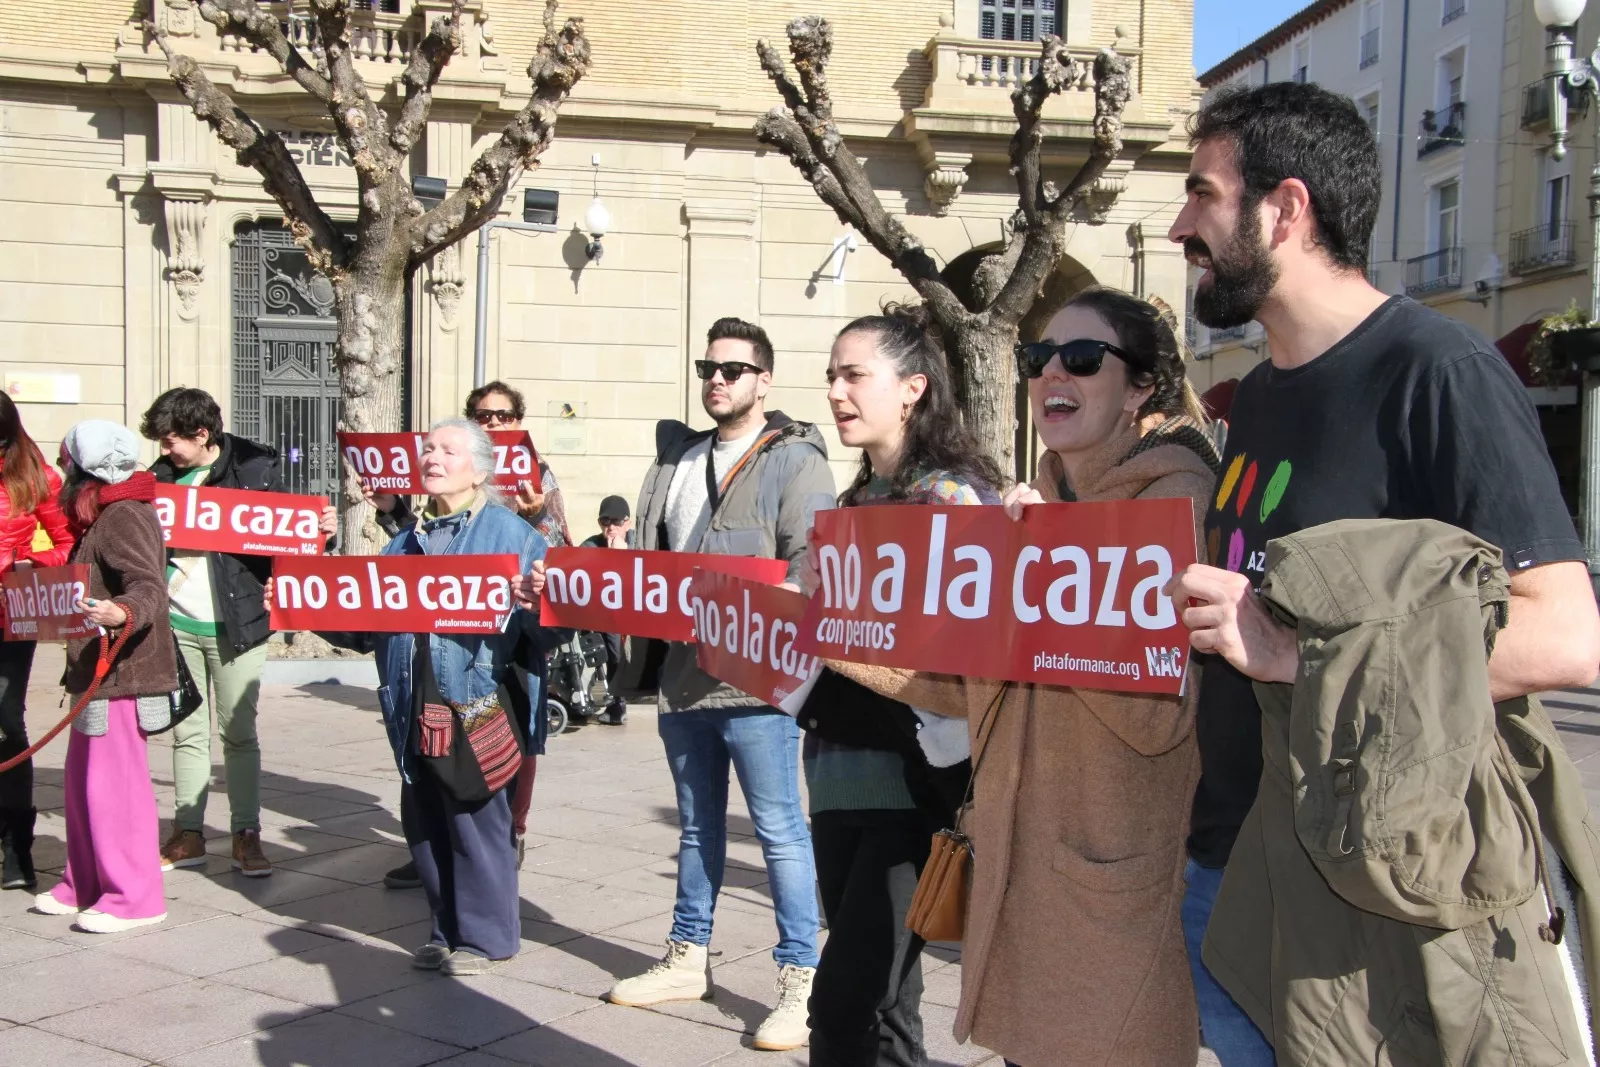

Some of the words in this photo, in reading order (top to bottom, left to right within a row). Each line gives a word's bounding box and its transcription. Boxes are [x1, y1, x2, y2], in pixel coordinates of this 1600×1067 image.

[288, 148, 355, 167] CIEN
[345, 446, 384, 474] no
[390, 446, 411, 474] a
[494, 445, 532, 475] za
[371, 476, 411, 490] perros
[155, 497, 176, 527] a
[185, 488, 221, 531] la
[230, 504, 319, 539] caza
[242, 543, 299, 554] plataformanac.org
[276, 575, 328, 610] no
[337, 575, 361, 610] a
[367, 562, 408, 610] la
[418, 575, 511, 611] caza
[545, 566, 592, 607] no
[600, 571, 623, 609] a
[634, 557, 668, 614] la
[819, 543, 862, 611] no
[871, 542, 906, 614] a
[923, 513, 993, 619] la
[1012, 544, 1177, 630] caza
[6, 587, 26, 618] no
[25, 586, 37, 617] a
[33, 572, 50, 616] la
[50, 581, 86, 616] caza
[435, 618, 493, 630] plataformanac.org
[692, 596, 721, 647] no
[726, 604, 738, 654] a
[743, 589, 764, 664] la
[816, 616, 845, 645] con
[844, 619, 896, 655] perros
[1034, 651, 1140, 681] plataformanac.org
[1145, 646, 1182, 678] NAC
